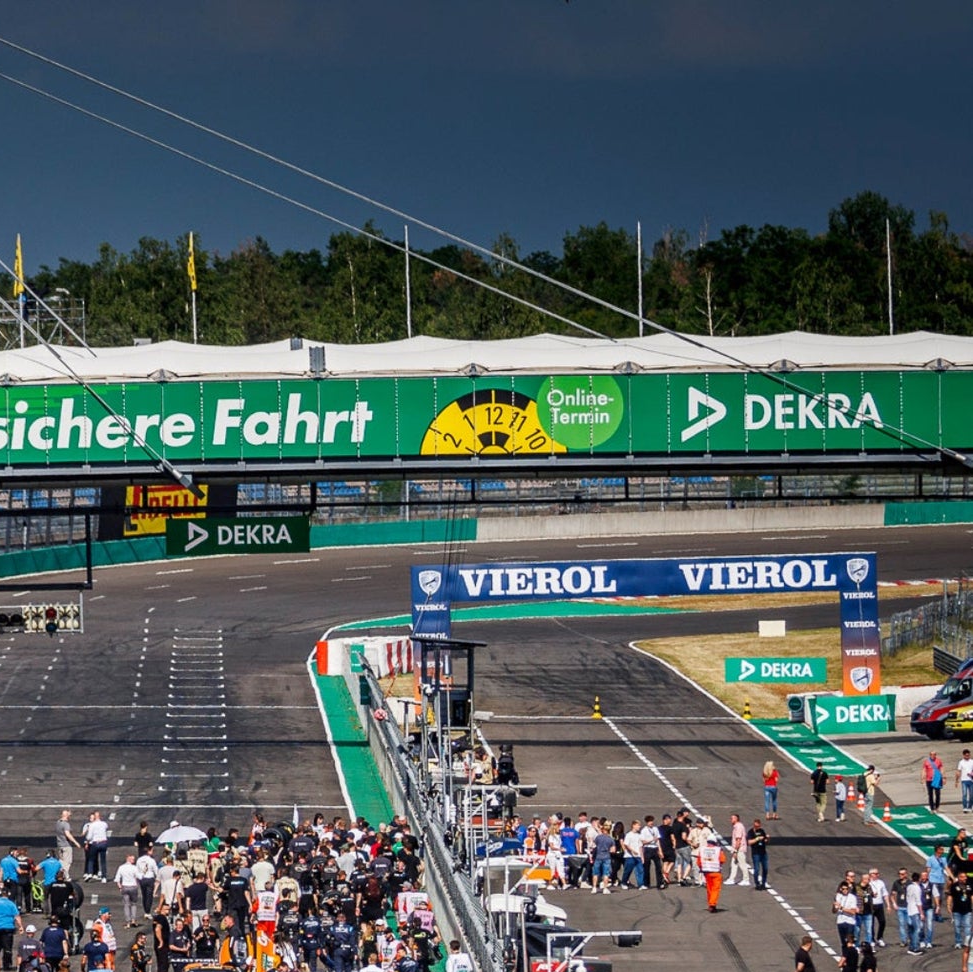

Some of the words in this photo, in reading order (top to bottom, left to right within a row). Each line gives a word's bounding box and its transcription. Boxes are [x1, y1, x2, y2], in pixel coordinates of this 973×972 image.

[547, 387, 614, 406] Online-
[212, 393, 373, 446] Fahrt
[485, 406, 504, 425] 12
[552, 407, 610, 424] Termin
[745, 392, 885, 431] DEKRA
[525, 428, 547, 450] 10
[217, 524, 292, 545] DEKRA
[459, 565, 617, 597] VIEROL
[678, 559, 837, 591] VIEROL
[842, 591, 875, 599] VIEROL
[844, 620, 876, 628] VIEROL
[845, 648, 877, 656] VIEROL
[761, 662, 813, 678] DEKRA
[836, 704, 892, 723] DEKRA
